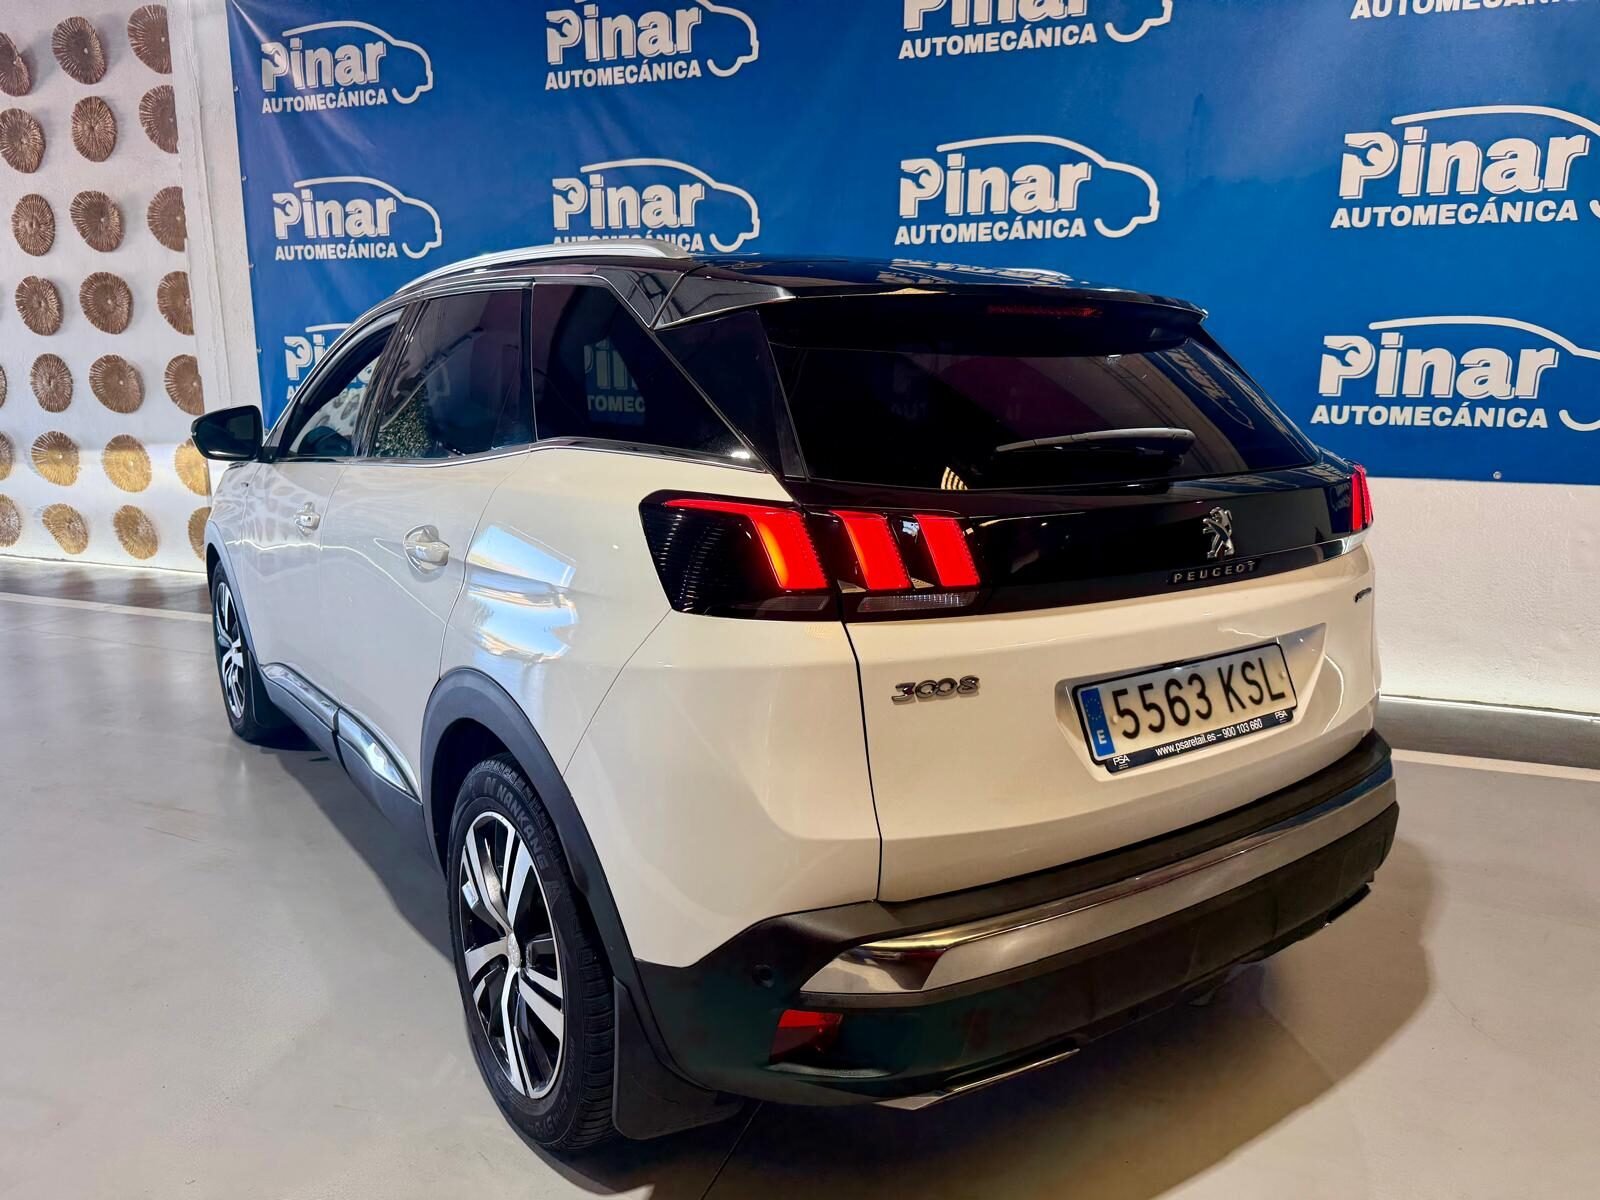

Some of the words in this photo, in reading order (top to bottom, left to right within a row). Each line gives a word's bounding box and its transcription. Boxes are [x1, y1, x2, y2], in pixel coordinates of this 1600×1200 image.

[545, 4, 703, 65] Pinar
[898, 24, 1098, 60] AUTOMECÁNICA
[261, 37, 387, 93] Pinar
[545, 59, 702, 91] AUTOMECÁNICA
[262, 88, 389, 115] AUTOMECÁNICA
[1339, 126, 1591, 201] Pinar
[553, 174, 706, 231] Pinar
[900, 153, 1092, 219] Pinar
[272, 182, 397, 240] Pinar
[1330, 197, 1578, 230] AUTOMECÁNICA
[894, 216, 1088, 246] AUTOMECÁNICA
[275, 238, 398, 261] AUTOMECÁNICA
[1318, 333, 1560, 401] Pinar
[1310, 400, 1549, 429] AUTOMECÁNICA
[1173, 560, 1256, 583] PEUGEOT
[891, 675, 980, 705] 3008
[1111, 673, 1212, 740] 5563
[1217, 655, 1286, 713] KSL
[1274, 710, 1288, 720] PSA
[1097, 730, 1107, 744] E
[1154, 733, 1217, 757] www.psaretail.es
[1222, 726, 1237, 739] 900
[1237, 723, 1250, 735] 103
[1113, 755, 1130, 766] PSA
